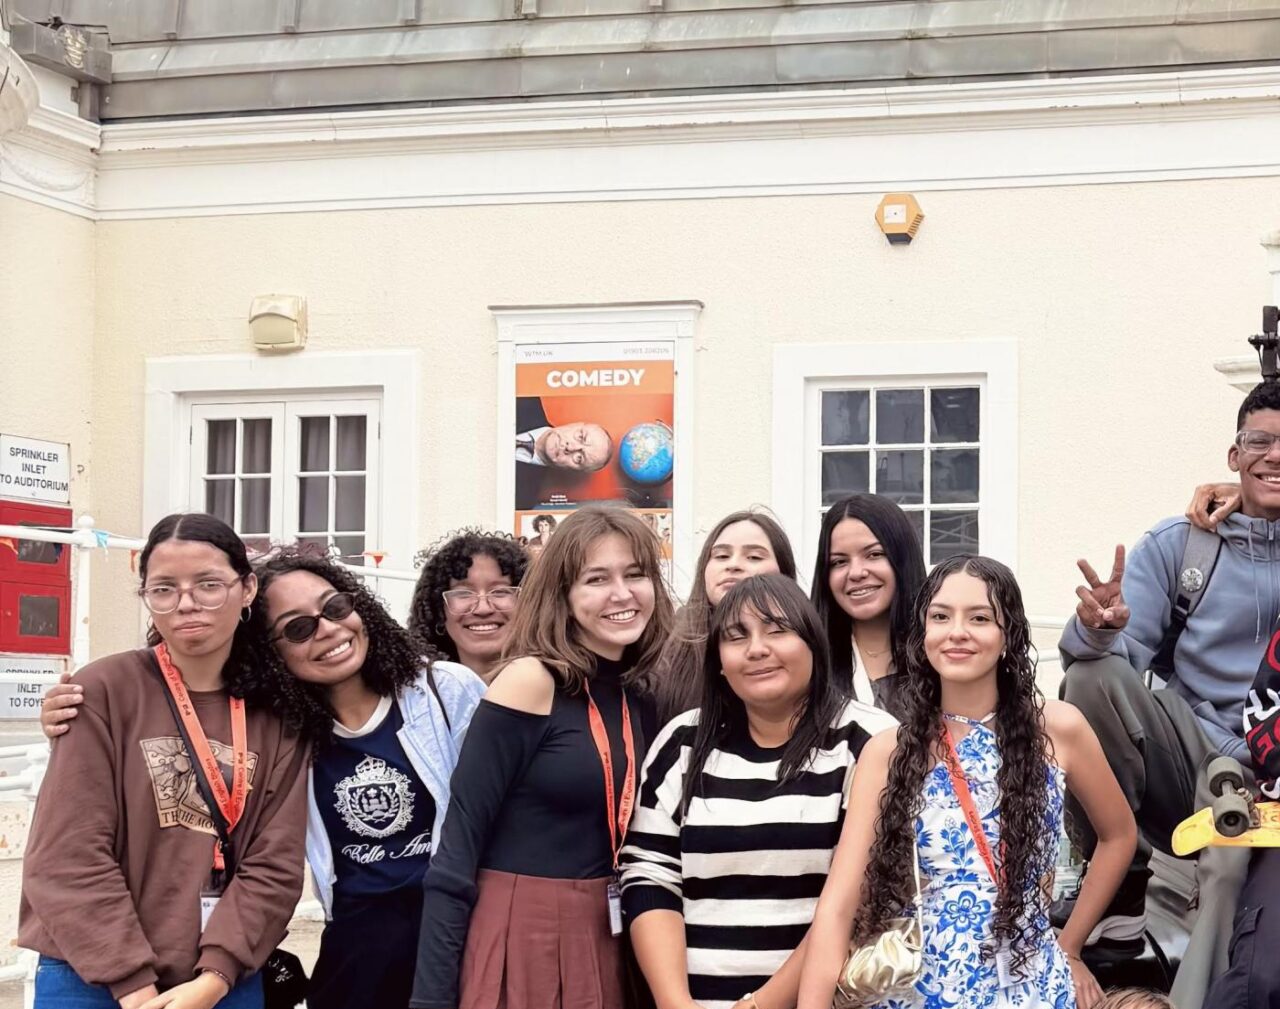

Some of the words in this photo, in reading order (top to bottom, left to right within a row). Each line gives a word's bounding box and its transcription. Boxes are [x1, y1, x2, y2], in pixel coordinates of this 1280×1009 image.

[546, 368, 645, 388] COMEDY
[9, 446, 59, 462] SPRINKLER
[21, 463, 46, 474] INLET
[0, 474, 12, 484] TO
[14, 476, 69, 491] AUDITORIUM
[17, 683, 42, 693] INLET
[9, 697, 22, 707] TO
[23, 698, 46, 707] FOYE
[342, 844, 385, 864] Belle
